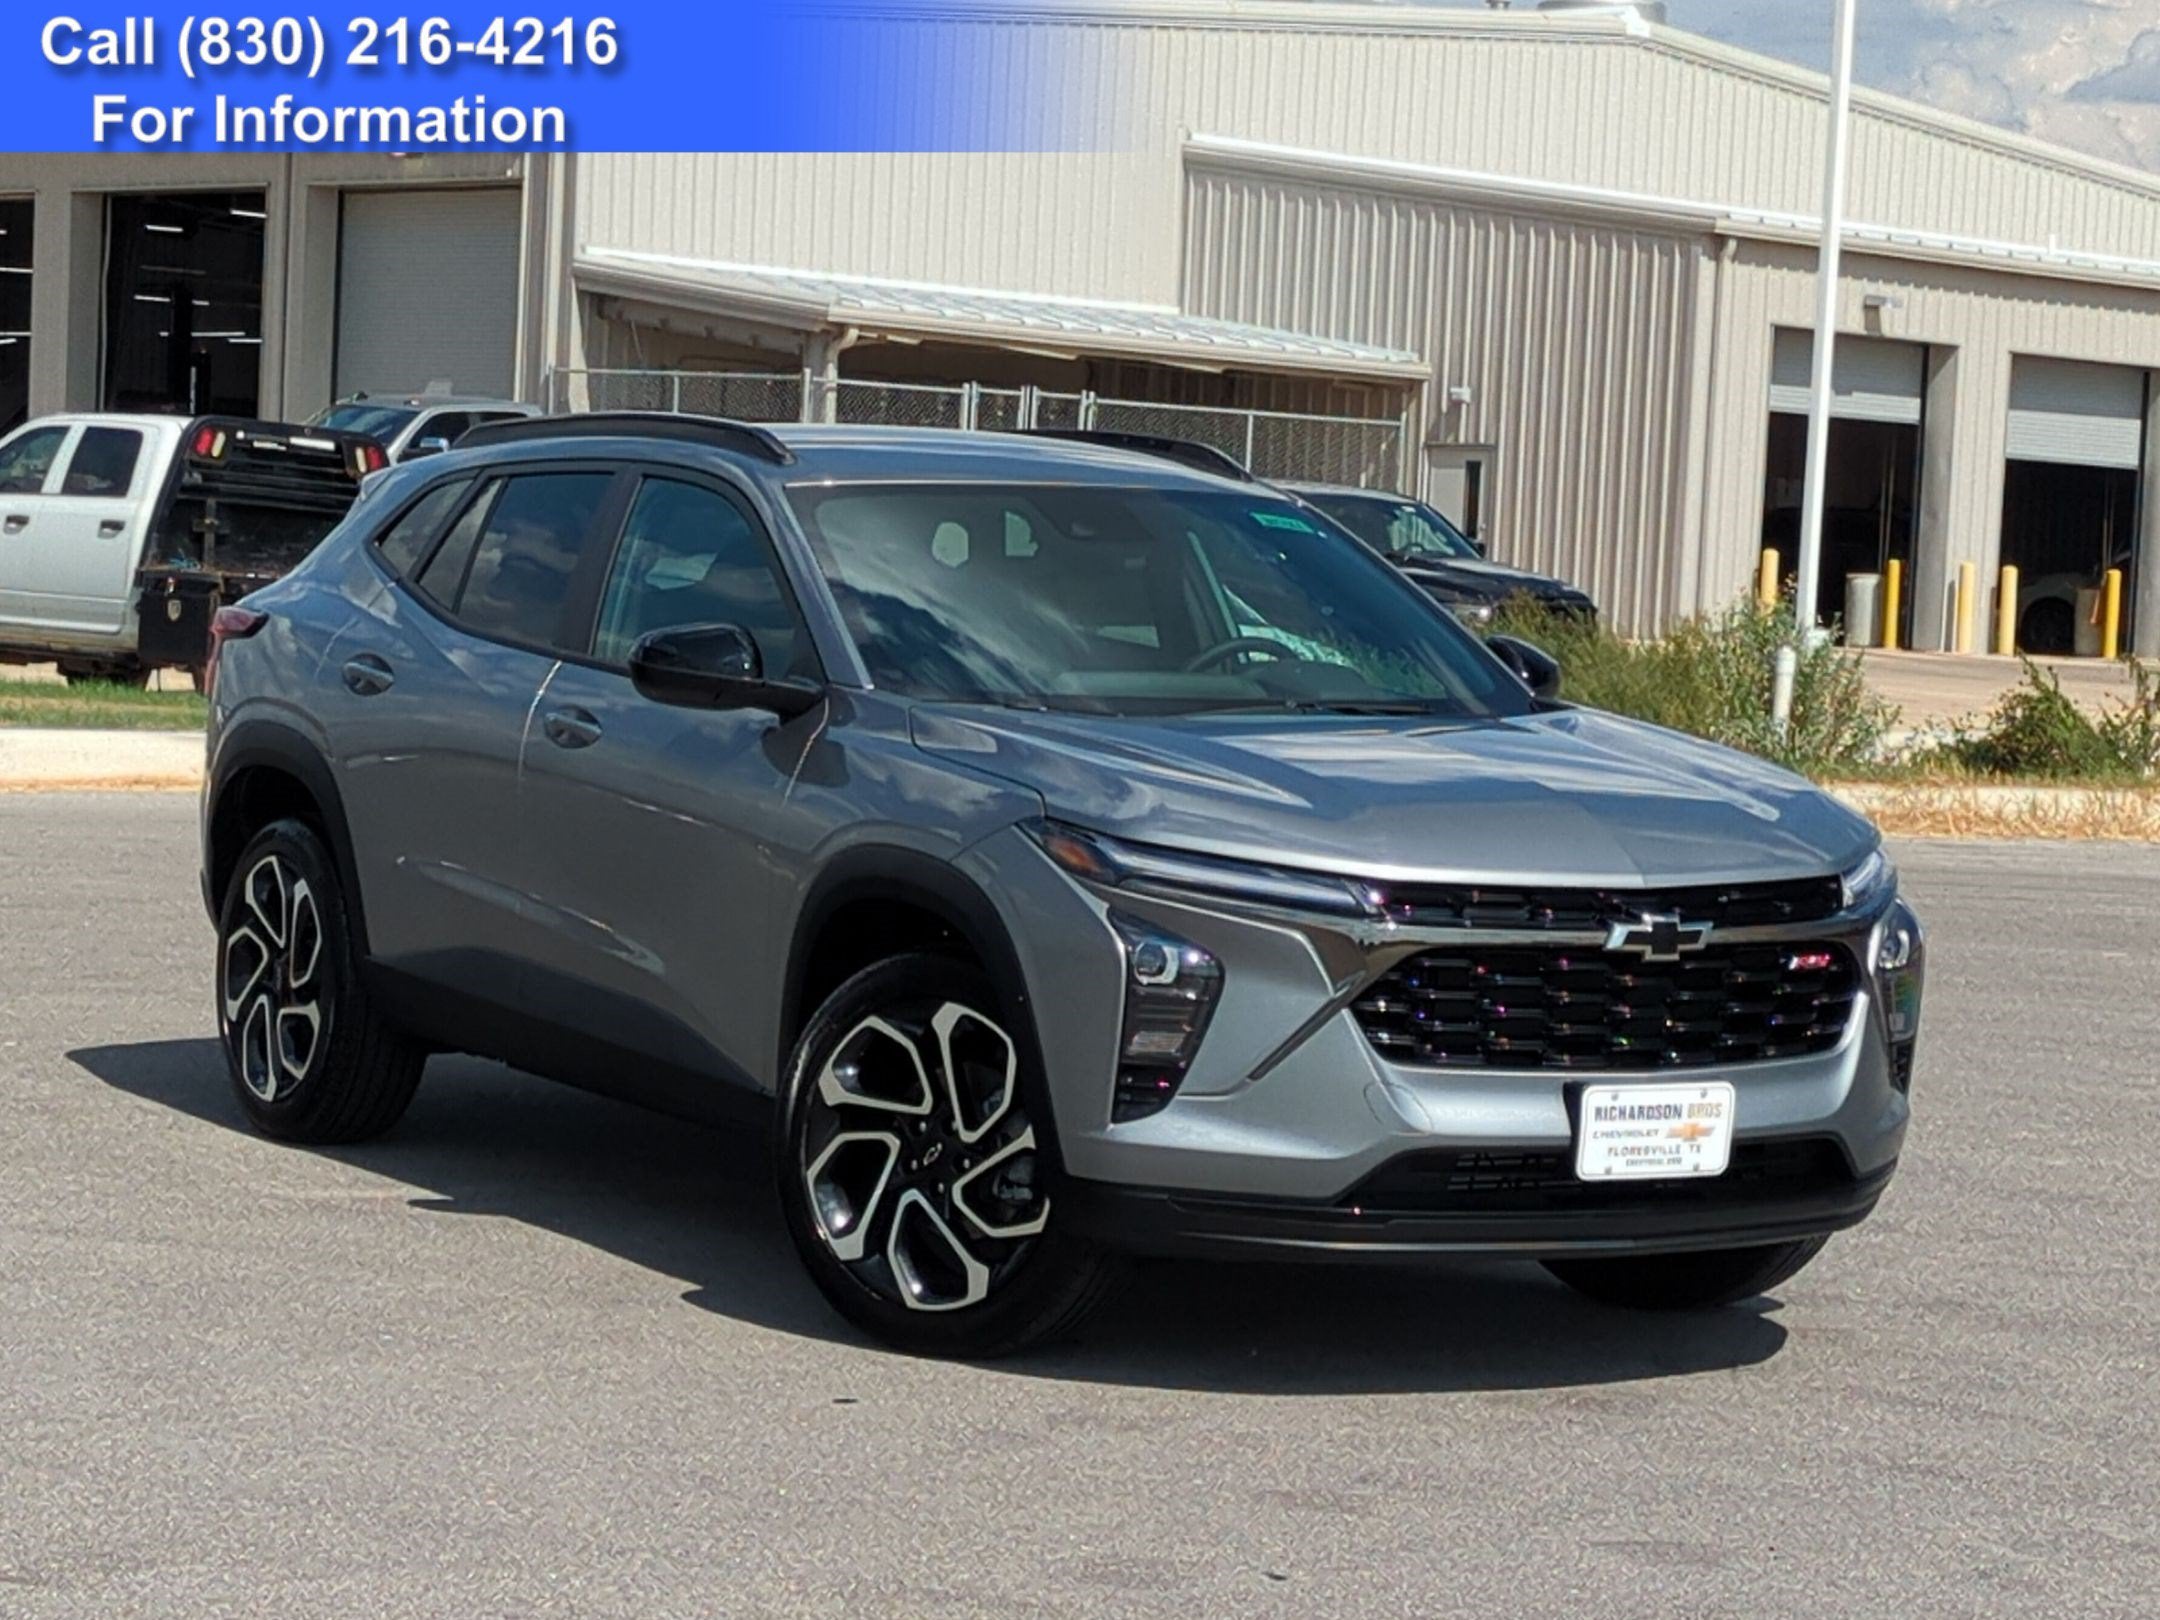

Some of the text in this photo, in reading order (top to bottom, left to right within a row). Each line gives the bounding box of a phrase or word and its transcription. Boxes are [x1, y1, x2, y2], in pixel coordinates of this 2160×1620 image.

[1595, 1103, 1722, 1121] RICHARDSON BROS
[1593, 1129, 1659, 1138] CHEVROLET
[1608, 1144, 1701, 1156] FLORESVILLE TX
